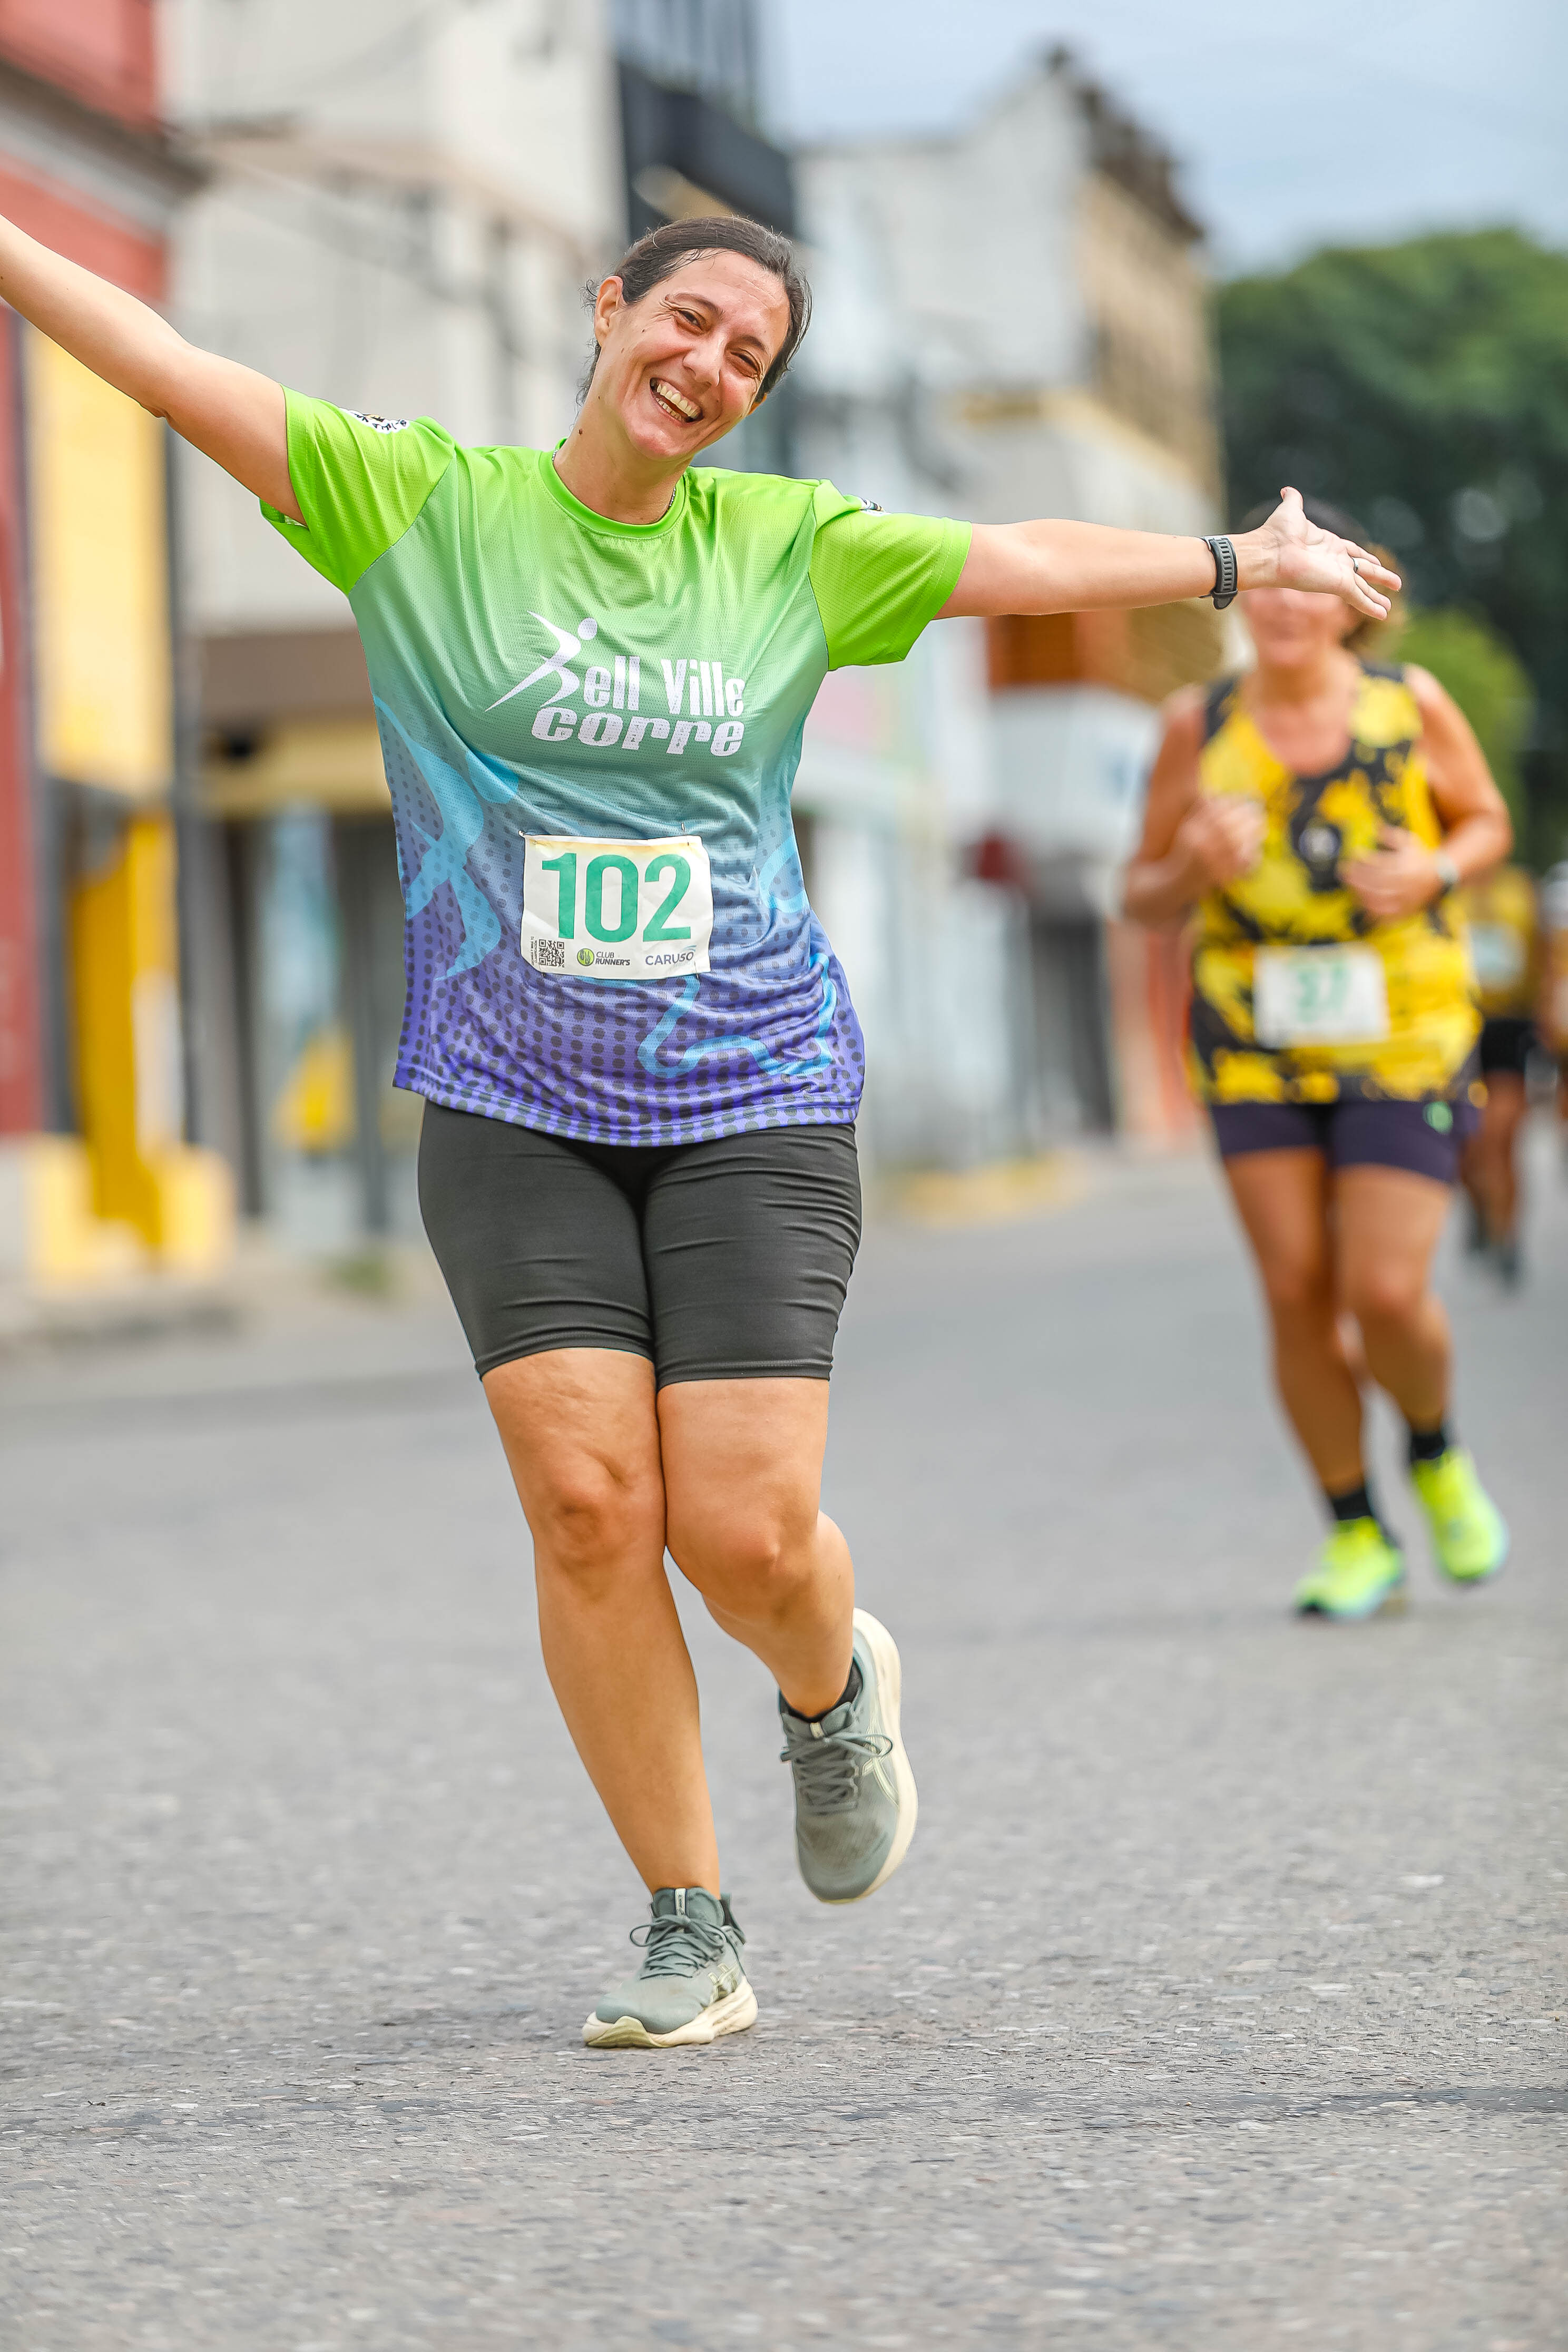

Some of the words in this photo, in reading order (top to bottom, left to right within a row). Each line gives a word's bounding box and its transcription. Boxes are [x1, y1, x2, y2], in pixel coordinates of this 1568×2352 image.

[661, 659, 746, 717] Ville
[542, 852, 691, 942] 102
[645, 952, 694, 966] CARUSO
